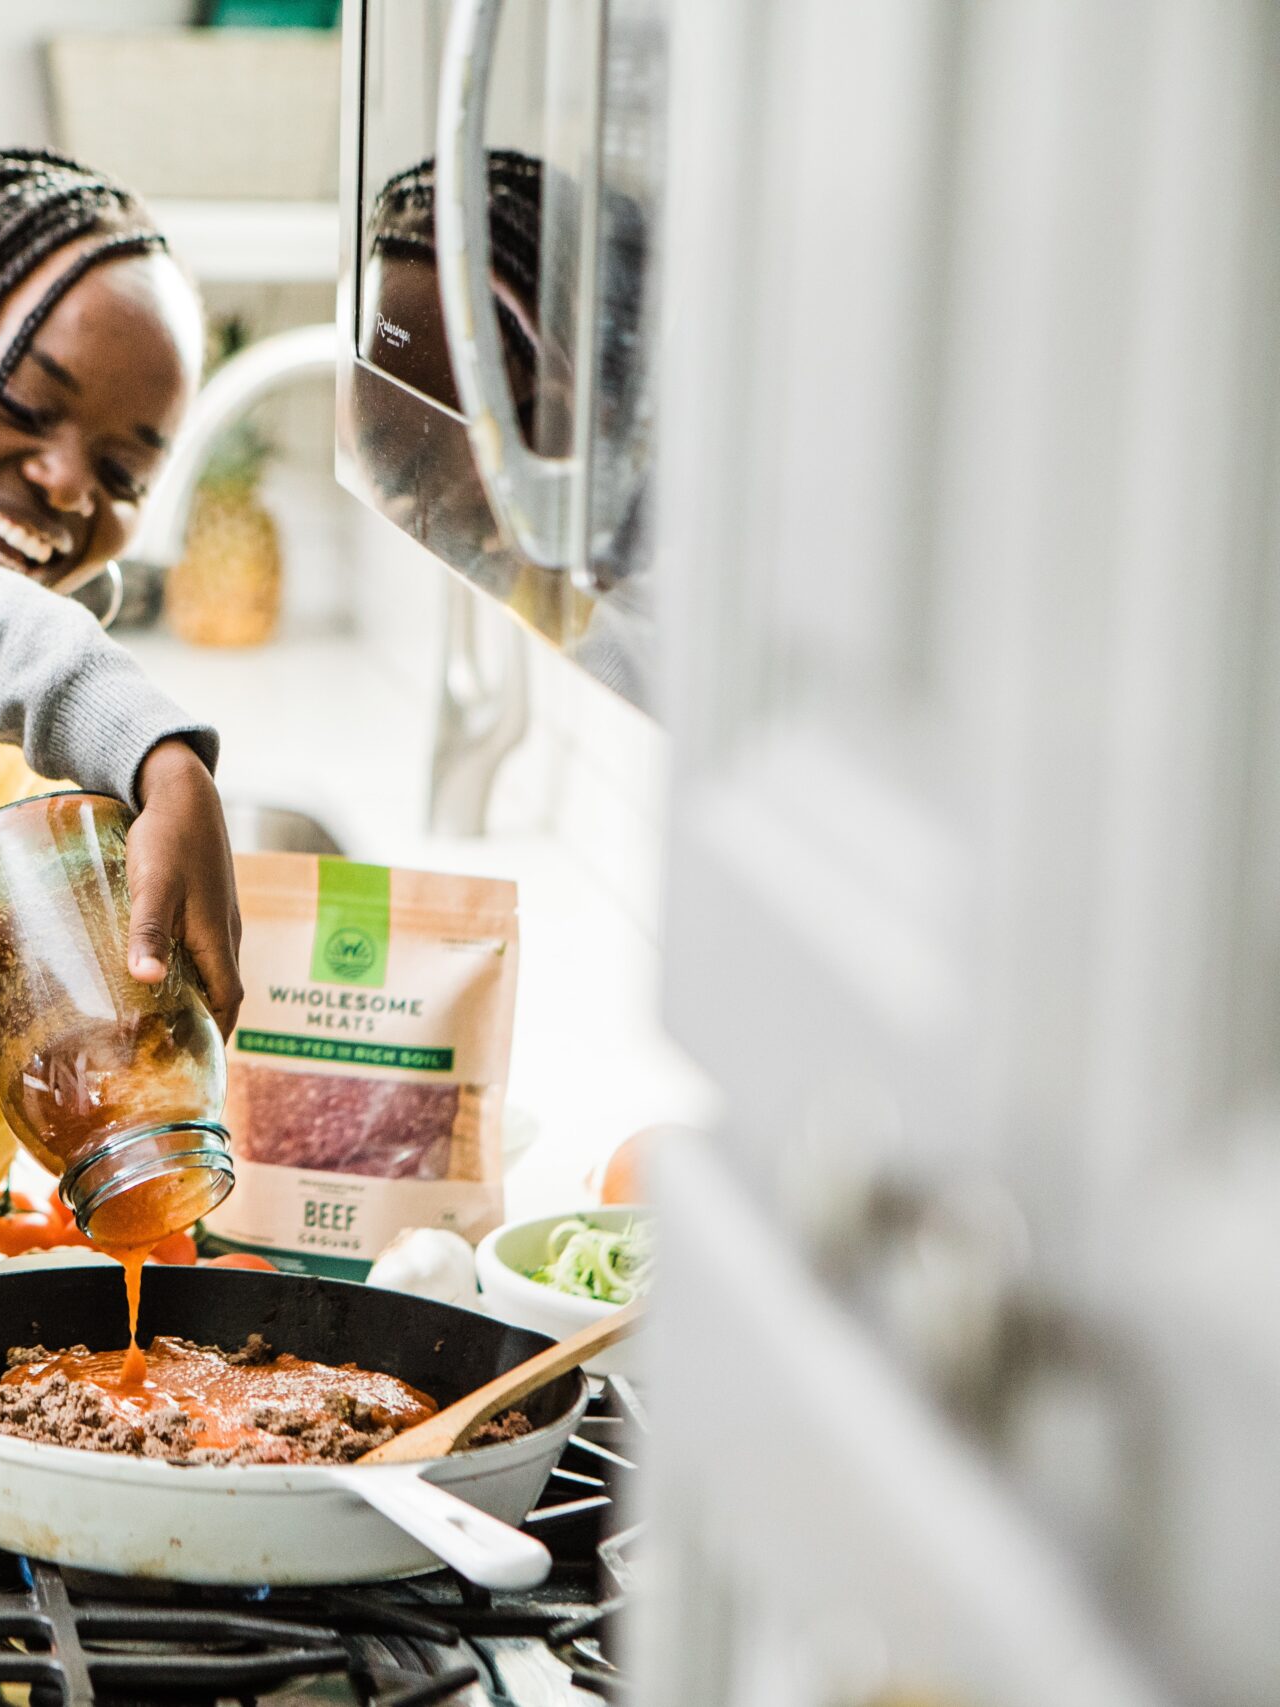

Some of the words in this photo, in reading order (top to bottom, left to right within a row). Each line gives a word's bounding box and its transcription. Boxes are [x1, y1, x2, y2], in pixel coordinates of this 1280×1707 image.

[269, 986, 424, 1015] WHOLESOME
[307, 1014, 376, 1032] MEATS
[304, 1201, 358, 1232] BEEF
